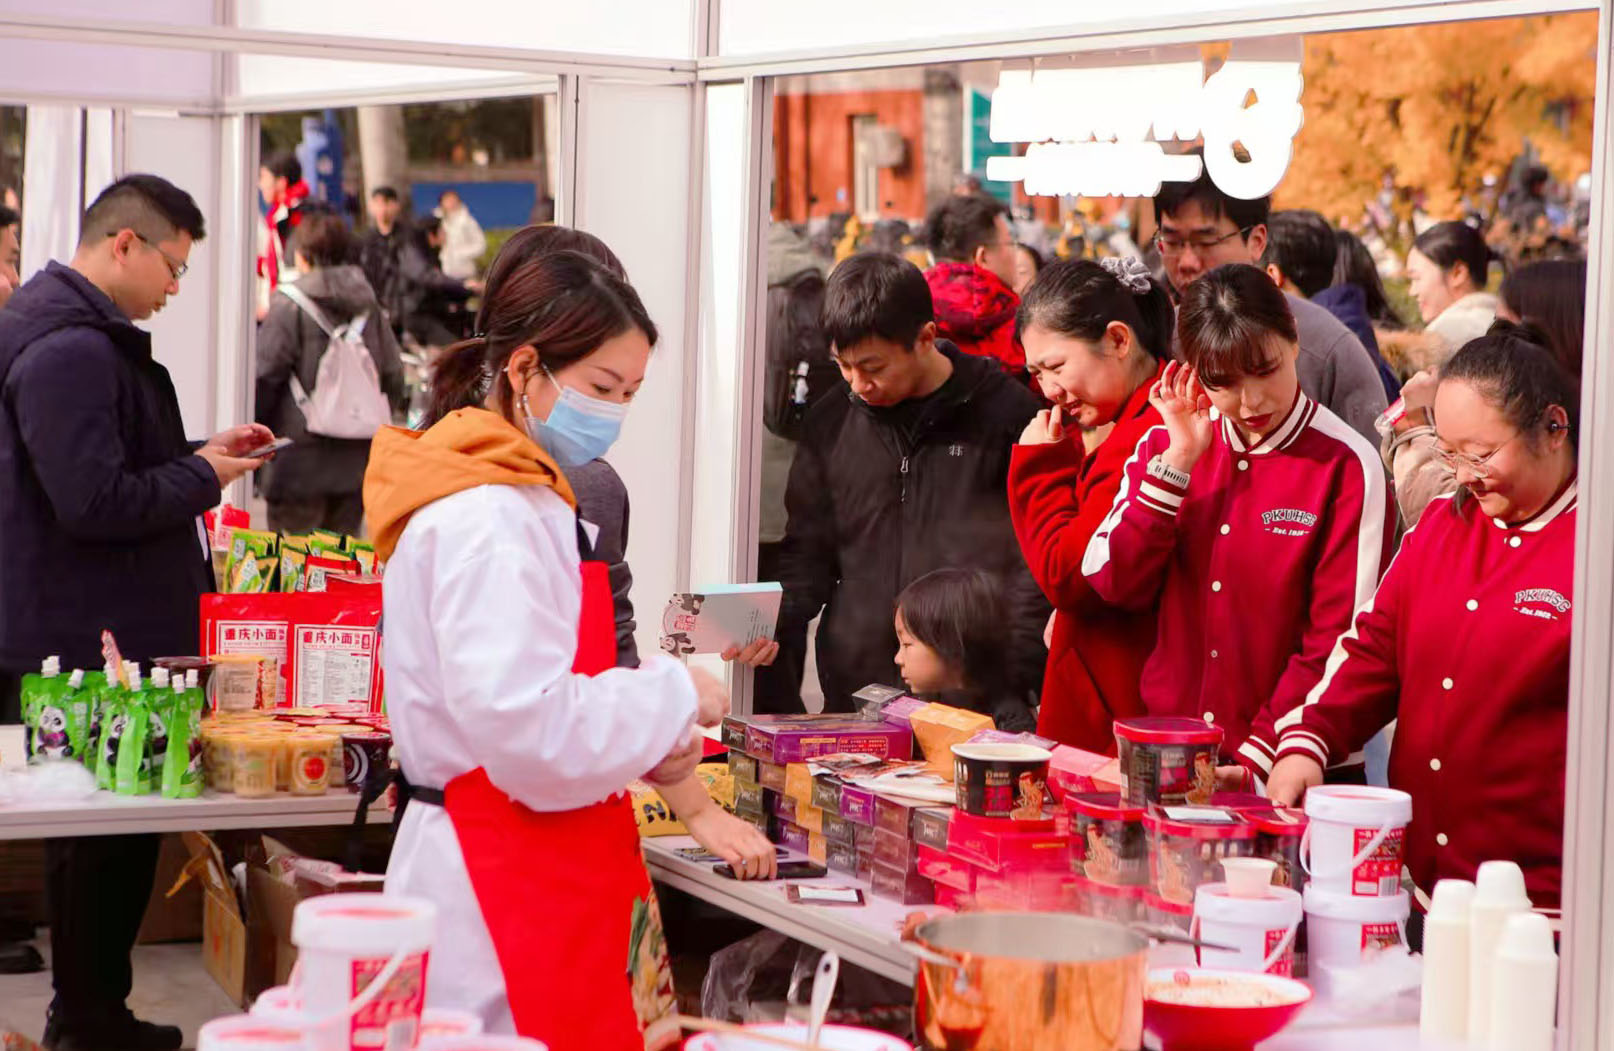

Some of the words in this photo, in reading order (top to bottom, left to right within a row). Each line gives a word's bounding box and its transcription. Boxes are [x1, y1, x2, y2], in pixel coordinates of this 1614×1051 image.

[1514, 588, 1572, 613] PKUHSC
[224, 628, 277, 641] 重庆小面
[303, 631, 352, 644] 重庆小面
